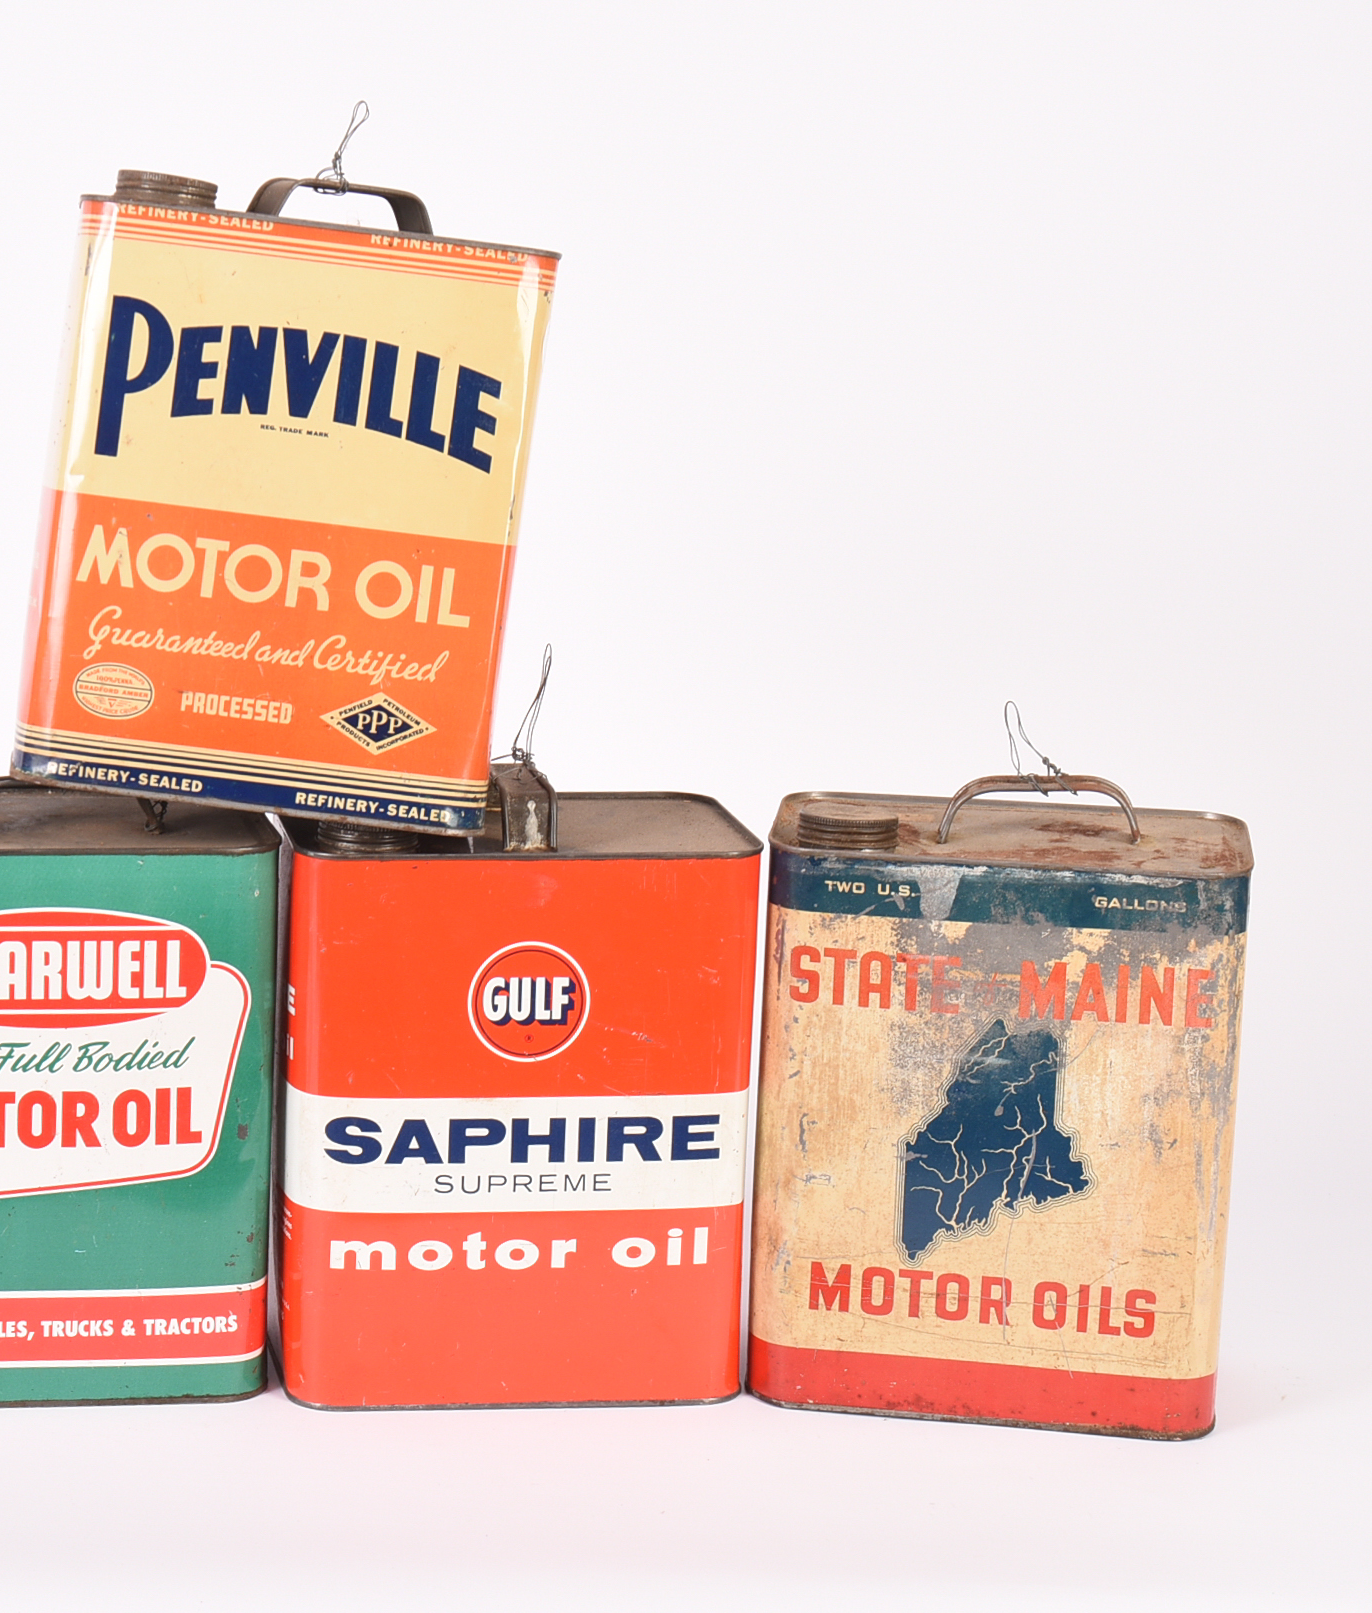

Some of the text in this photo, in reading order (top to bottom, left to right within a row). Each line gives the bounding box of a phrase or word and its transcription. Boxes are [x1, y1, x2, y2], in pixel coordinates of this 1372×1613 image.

[94, 294, 502, 475] PENVILLE
[279, 426, 303, 434] TRADE
[306, 429, 329, 438] MARK
[76, 524, 471, 628] MOTOR OIL
[83, 605, 450, 686] Guaranteed and Certified
[79, 683, 149, 698] BRADFORD AMBER
[180, 690, 293, 725] PROCESSED
[339, 698, 421, 726] PENFIELD PETROLEUM
[356, 709, 403, 734] PPP
[336, 721, 424, 751] PRODUCTS INCORPORATED
[47, 761, 203, 793] REFINERY-SEALED
[295, 791, 451, 823] REFINERY-SEALED
[825, 879, 915, 897] TWO U.S.
[1094, 896, 1187, 913] GALLONS
[482, 976, 577, 1026] GULF
[789, 945, 962, 1015] STATE
[1017, 960, 1214, 1029] MAINE
[72, 1036, 196, 1073] Bodied
[112, 1086, 203, 1148] OIL
[324, 1113, 722, 1165] SAPHIRE
[433, 1173, 612, 1195] SUPREME
[329, 1226, 710, 1271] motor oil
[809, 1261, 1157, 1339] MOTOR OILS
[41, 1318, 115, 1339] TRUCKS
[120, 1318, 137, 1337] &
[142, 1314, 239, 1337] TRACTORS
